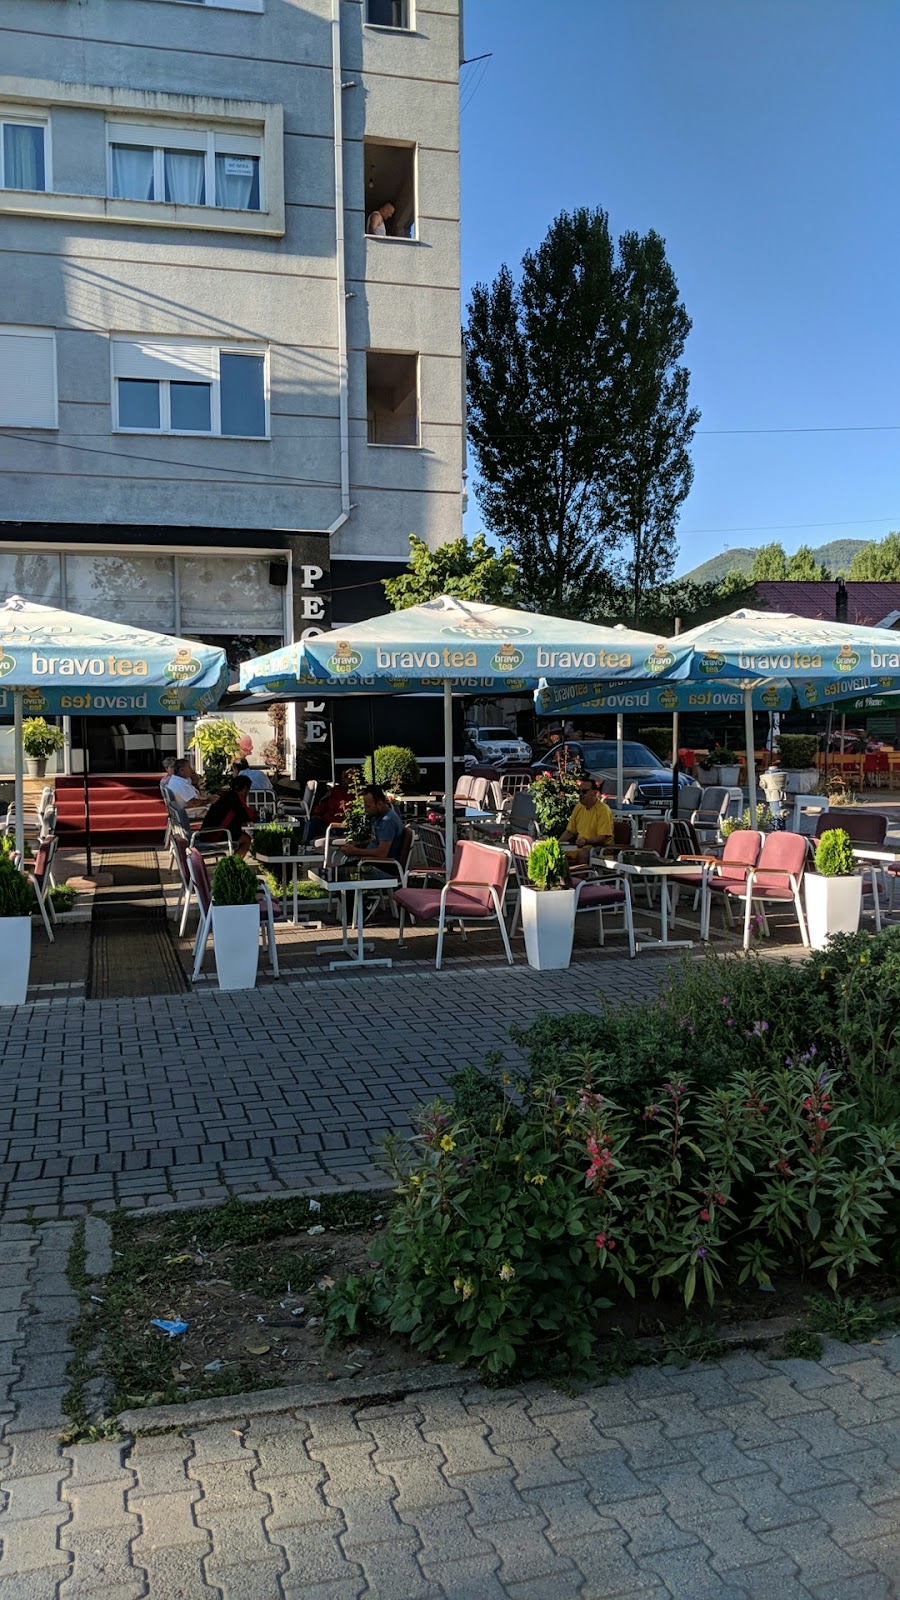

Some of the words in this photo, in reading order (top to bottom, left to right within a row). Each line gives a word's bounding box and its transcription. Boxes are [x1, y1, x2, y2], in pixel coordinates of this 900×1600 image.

[331, 655, 358, 665] bravo
[376, 647, 440, 668] bravo
[443, 648, 478, 668] tea
[494, 654, 519, 664] bravo
[537, 647, 596, 668] bravo
[599, 648, 632, 668] tea
[647, 655, 671, 665] bravo
[701, 658, 723, 667] bravo
[738, 651, 791, 670] bravo
[793, 652, 822, 669] tea
[836, 656, 857, 664] bravo
[870, 649, 900, 668] bra
[32, 652, 105, 676] bravo
[108, 655, 148, 676] tea
[167, 661, 196, 673] bravo
[336, 664, 351, 672] tea
[498, 663, 512, 671] tea
[651, 664, 665, 672] tea
[705, 665, 719, 673] tea
[172, 671, 189, 680] tea
